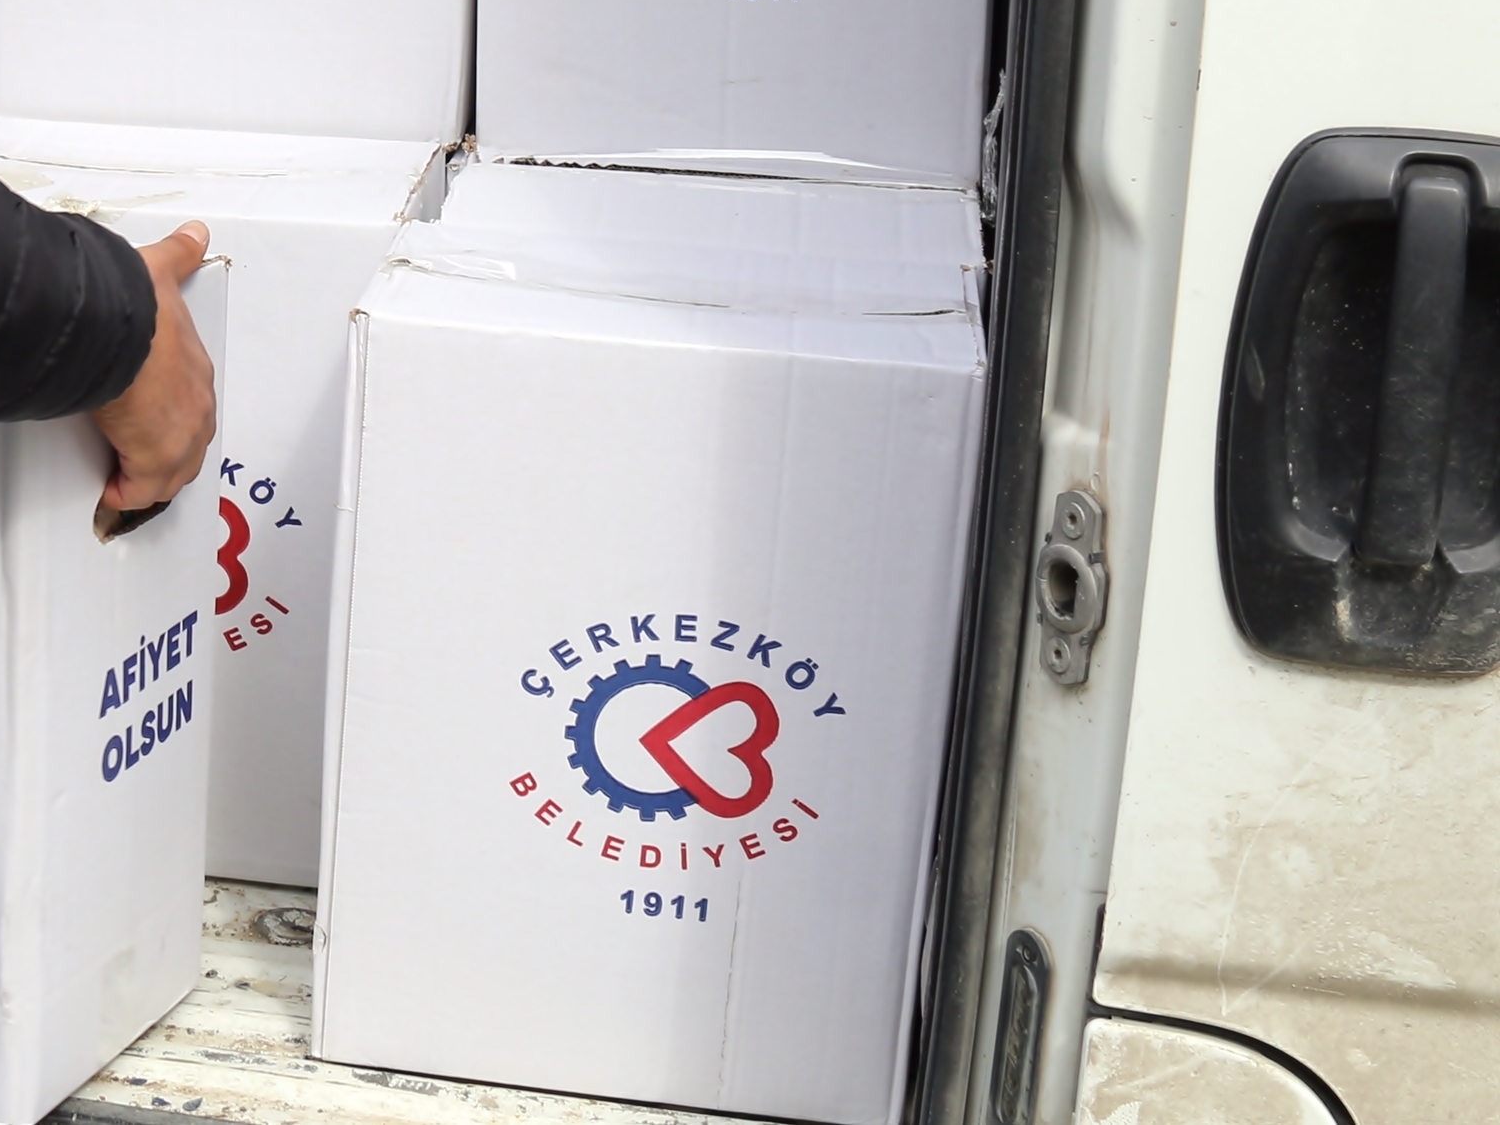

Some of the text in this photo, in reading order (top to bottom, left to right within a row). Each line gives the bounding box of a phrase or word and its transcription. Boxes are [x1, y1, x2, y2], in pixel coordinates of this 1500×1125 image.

[98, 610, 199, 720] AFİYET
[519, 613, 847, 718] ÇERKEZKÖY
[101, 679, 193, 782] OLSUN
[508, 771, 820, 871] BELEDİYESİ
[620, 888, 710, 922] 1911
